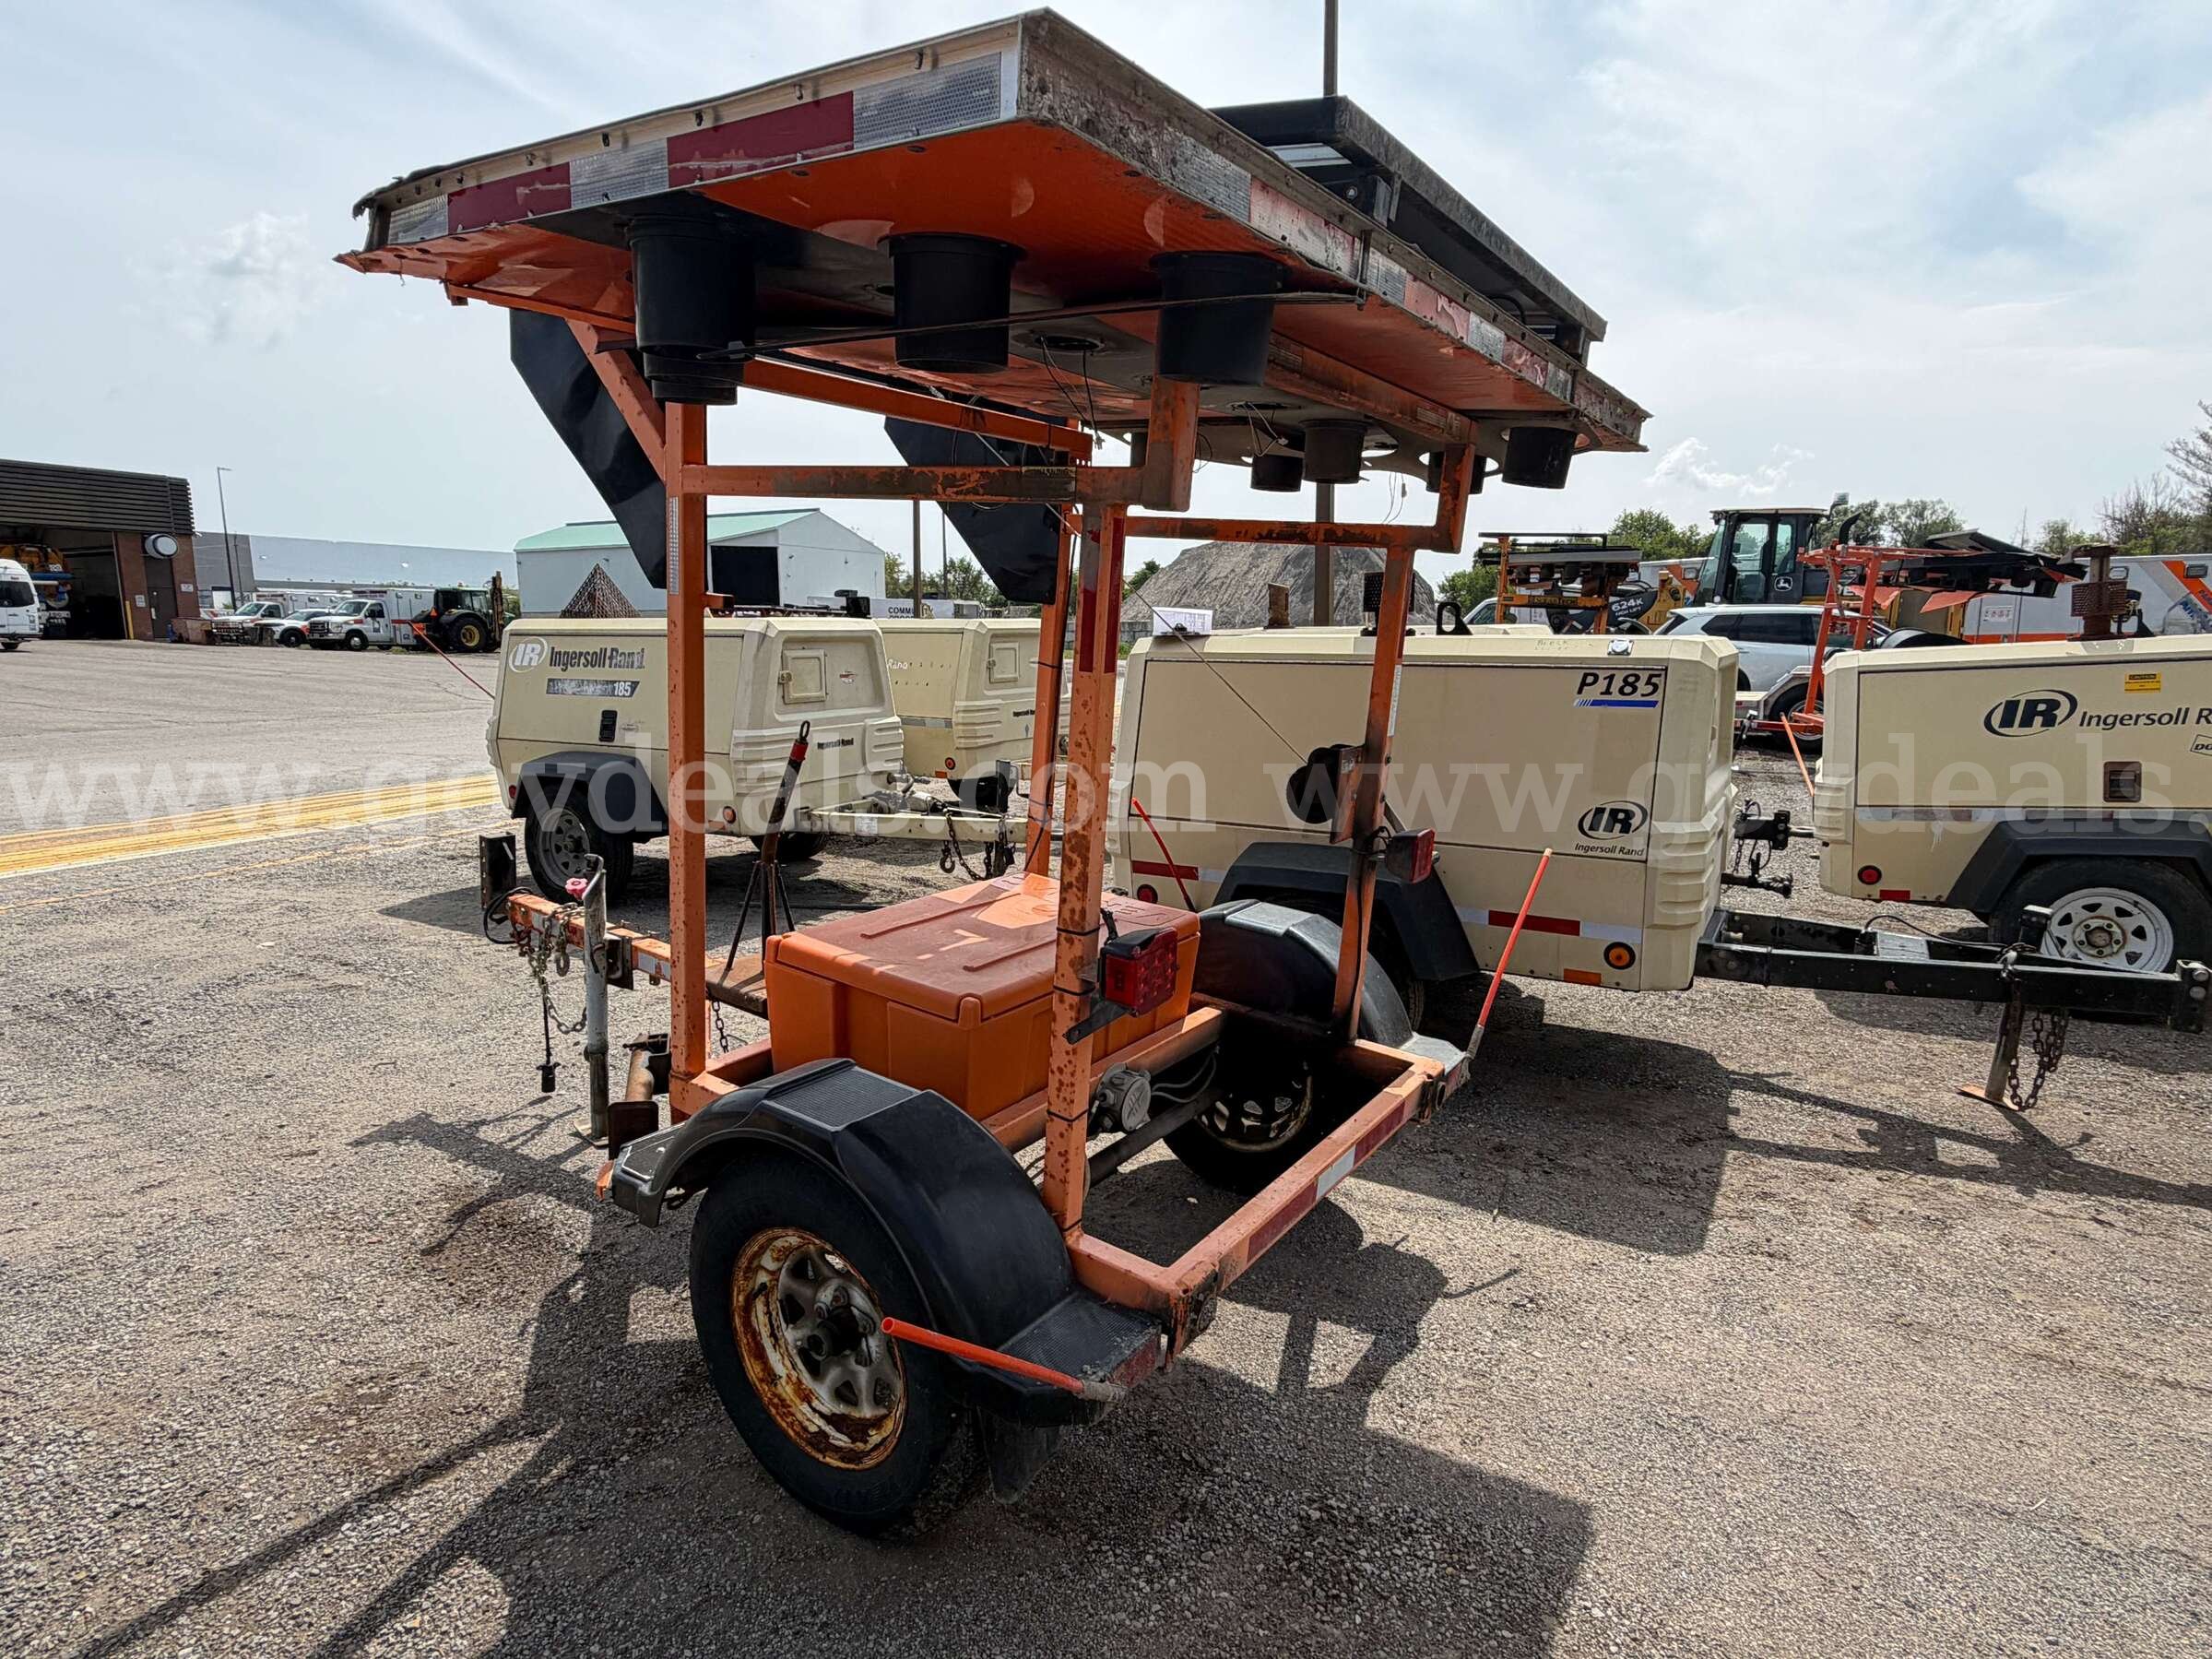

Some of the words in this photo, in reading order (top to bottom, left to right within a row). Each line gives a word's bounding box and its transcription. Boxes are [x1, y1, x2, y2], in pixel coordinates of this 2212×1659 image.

[1612, 598, 1643, 611] 624K
[515, 643, 541, 667] IR
[613, 681, 632, 696] 185
[1577, 672, 1662, 697] P185
[1998, 698, 2062, 729] IR
[2078, 706, 2191, 730] Ingersoll
[1588, 806, 1637, 835] IR
[1574, 843, 1617, 854] Ingersoll
[1618, 845, 1645, 857] Rand
